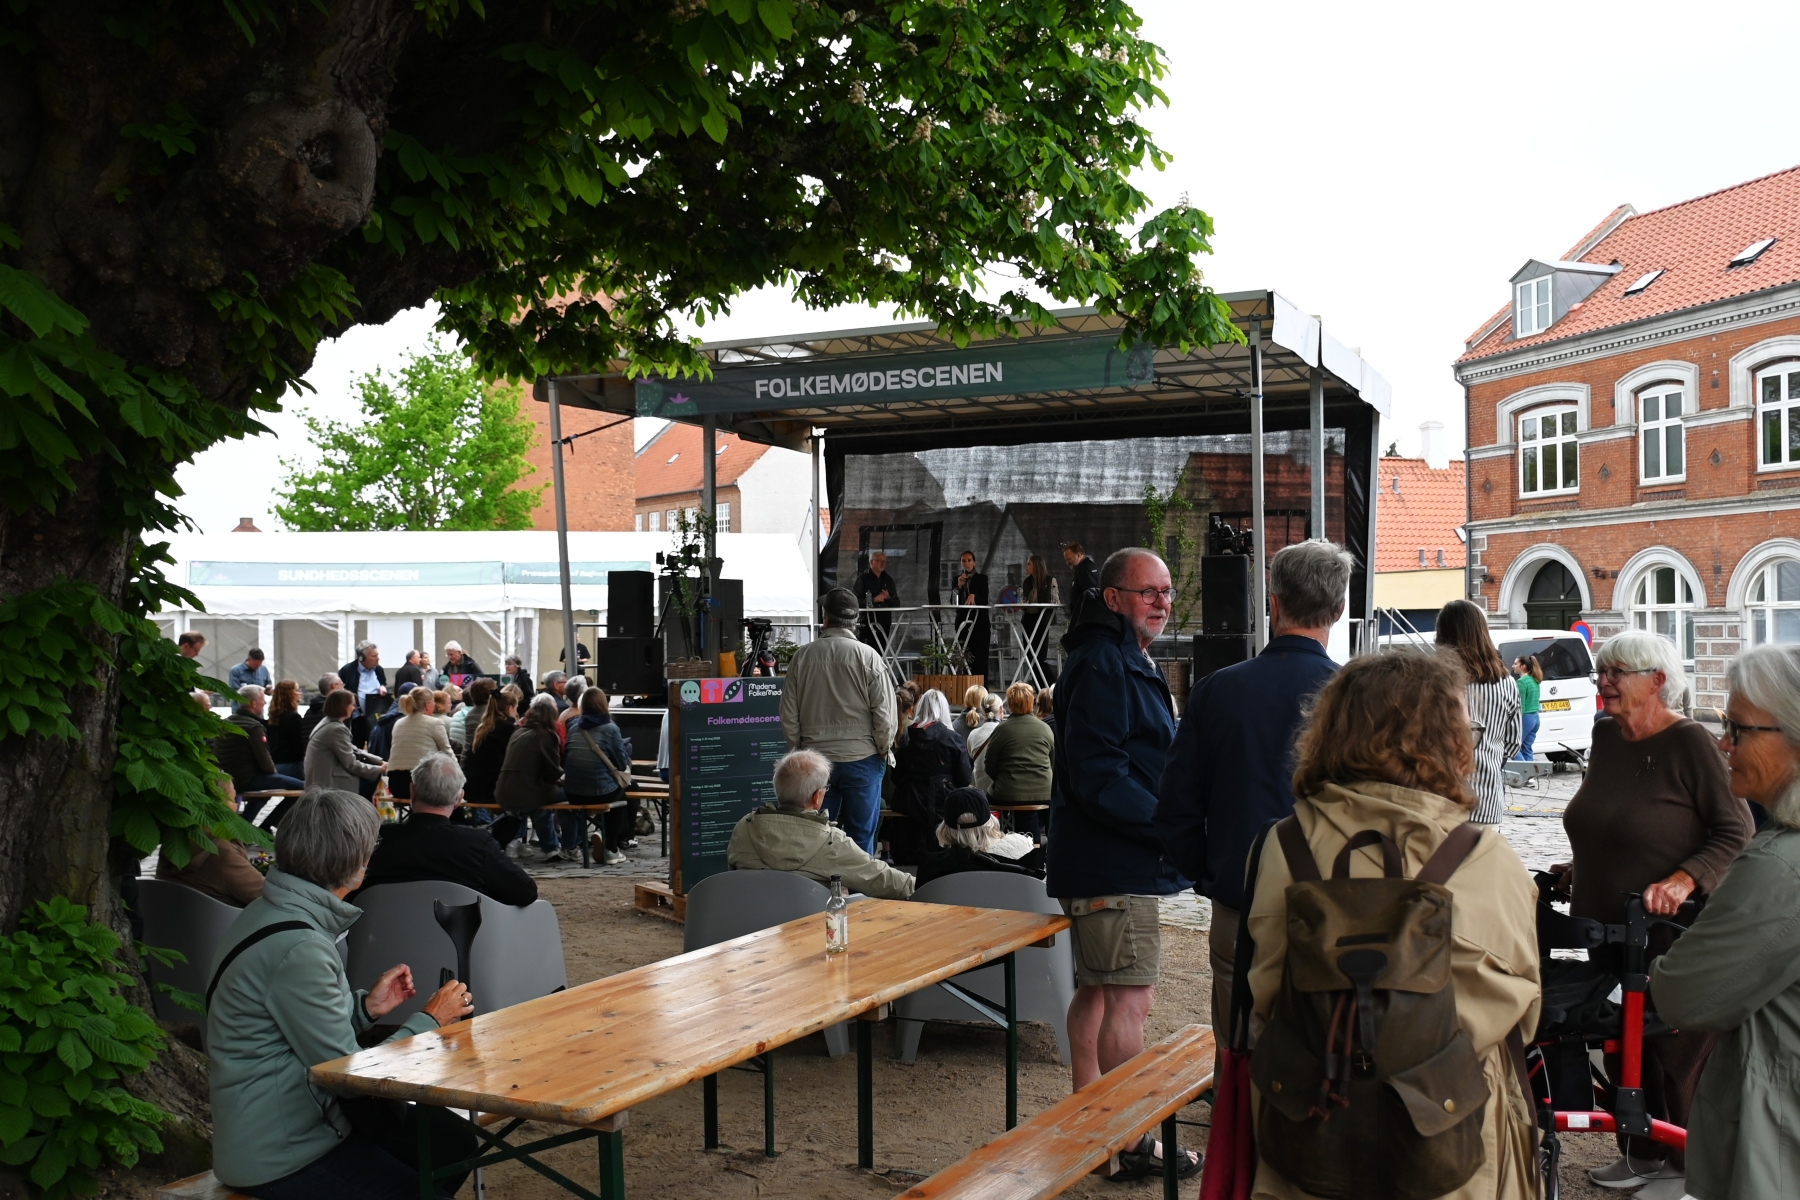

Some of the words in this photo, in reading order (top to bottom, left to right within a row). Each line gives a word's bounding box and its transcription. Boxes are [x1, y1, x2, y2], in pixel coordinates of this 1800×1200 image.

[755, 361, 1003, 399] FOLKEMØDESCENEN
[278, 569, 419, 581] SUNDHEDSSCENEN
[748, 689, 783, 697] FolkeMød
[707, 715, 782, 726] Folkemødescene
